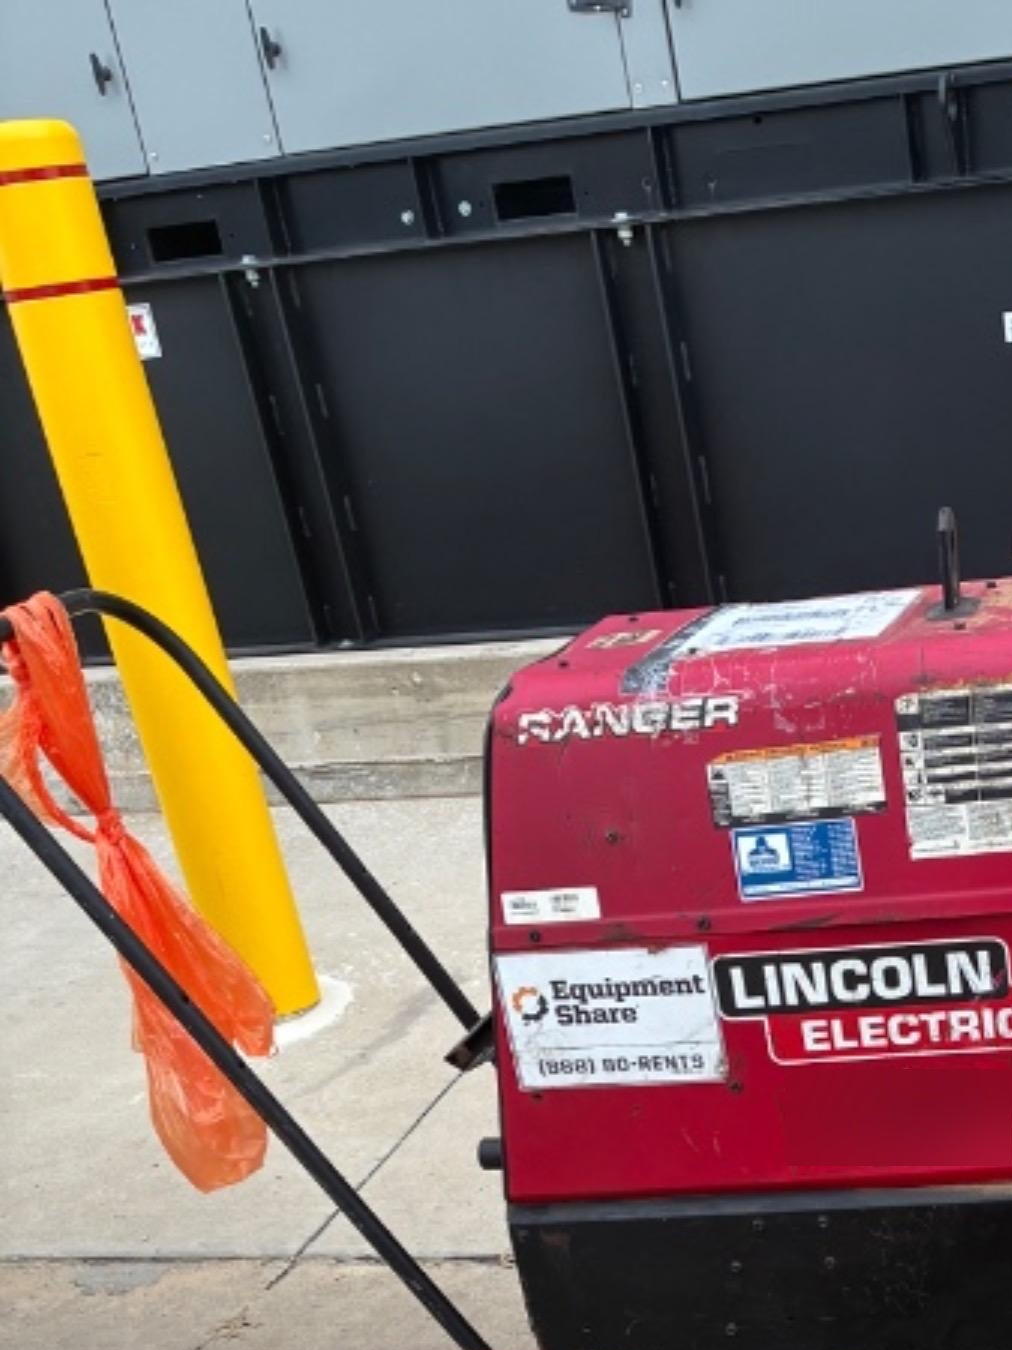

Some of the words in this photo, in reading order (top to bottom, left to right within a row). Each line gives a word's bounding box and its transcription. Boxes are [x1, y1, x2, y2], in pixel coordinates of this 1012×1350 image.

[517, 695, 739, 745] RANGER
[549, 974, 706, 1005] Equipment
[729, 950, 996, 1010] LINCOLN
[555, 1004, 637, 1026] Share
